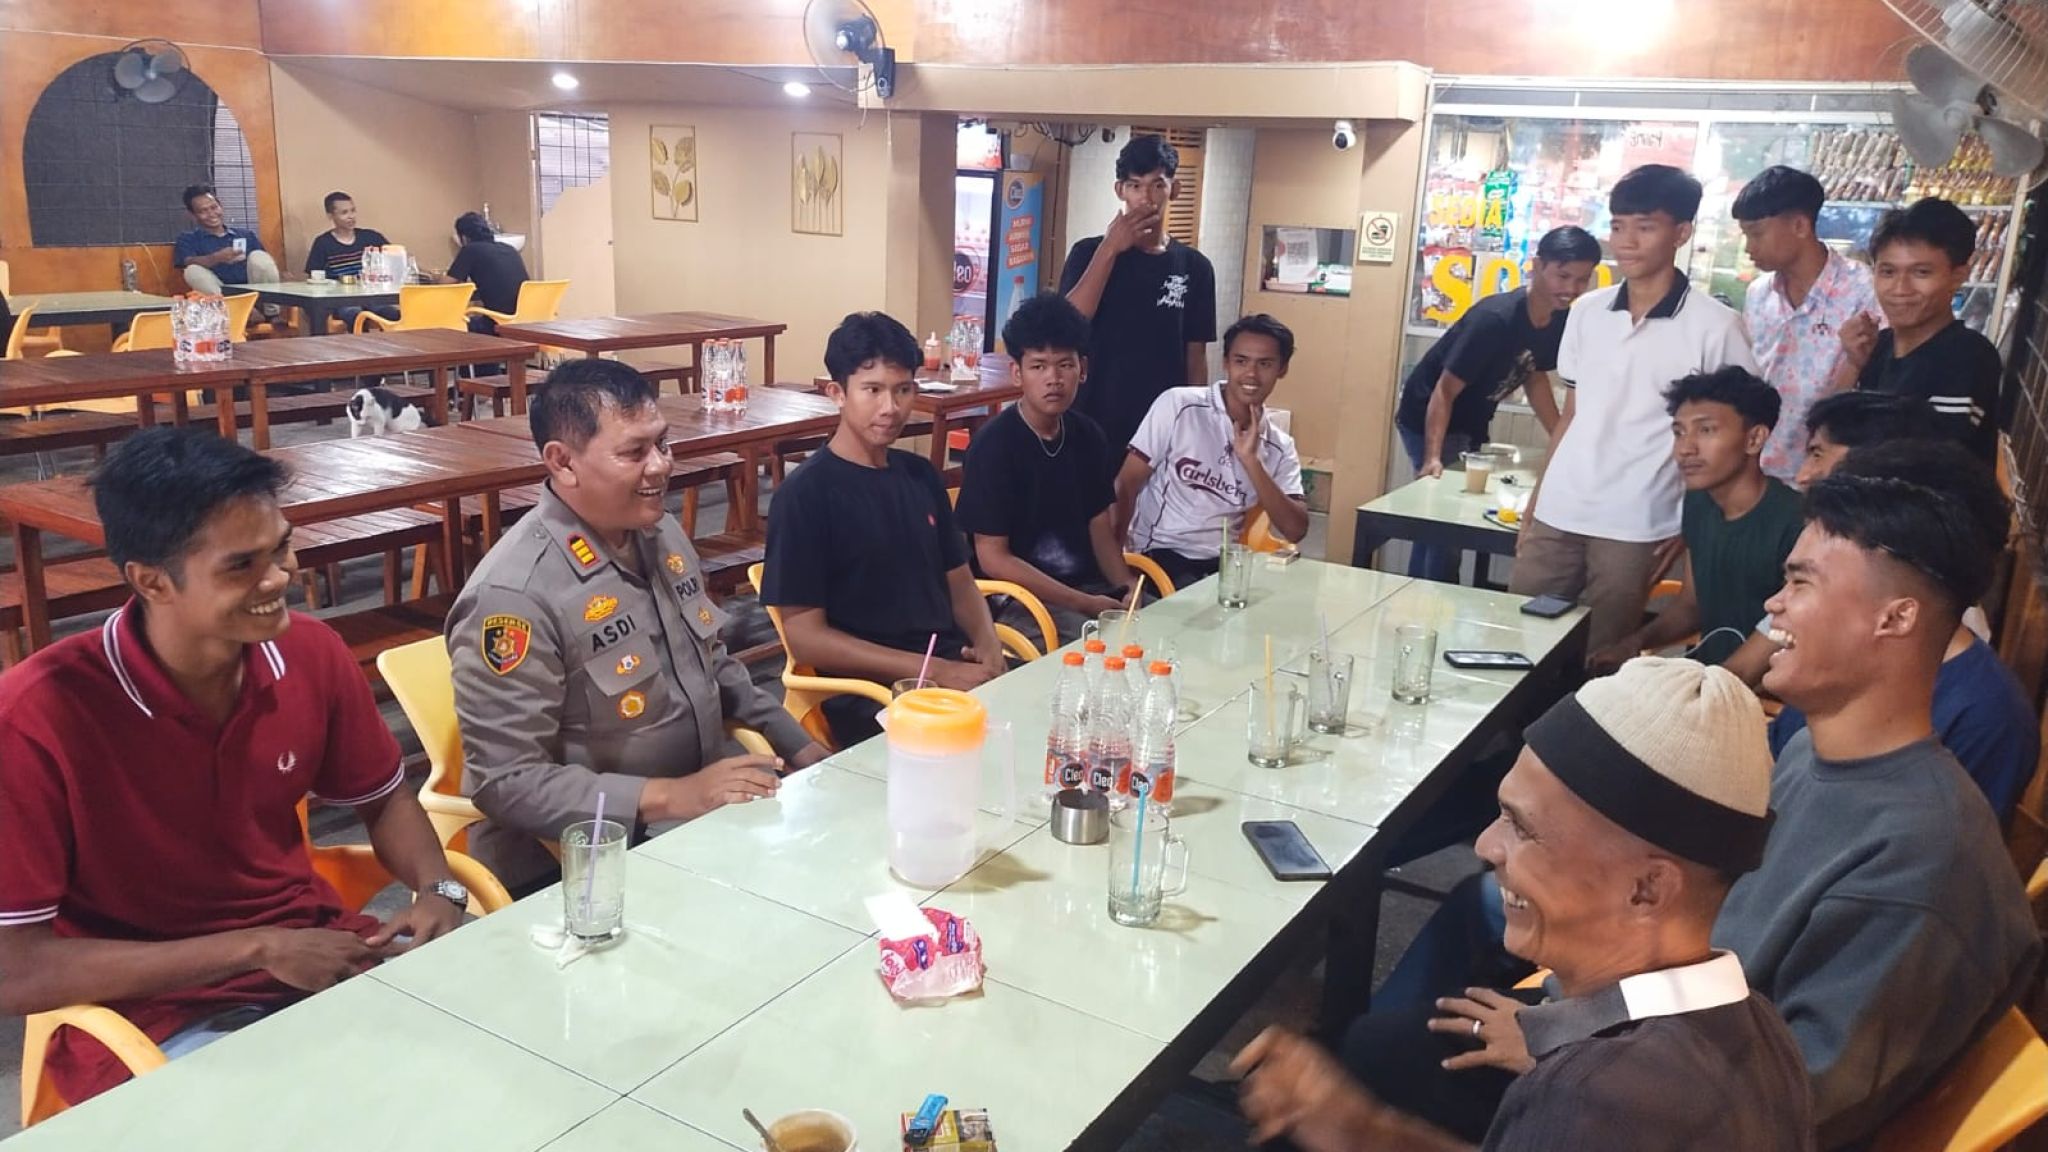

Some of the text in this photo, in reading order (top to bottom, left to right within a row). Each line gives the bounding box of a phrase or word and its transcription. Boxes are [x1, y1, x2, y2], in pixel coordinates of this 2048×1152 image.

[1428, 194, 1504, 228] SEDIA
[1423, 255, 1613, 323] SO
[592, 613, 636, 653] ASDI
[1065, 768, 1084, 781] Cleo
[1094, 771, 1112, 787] Cleo
